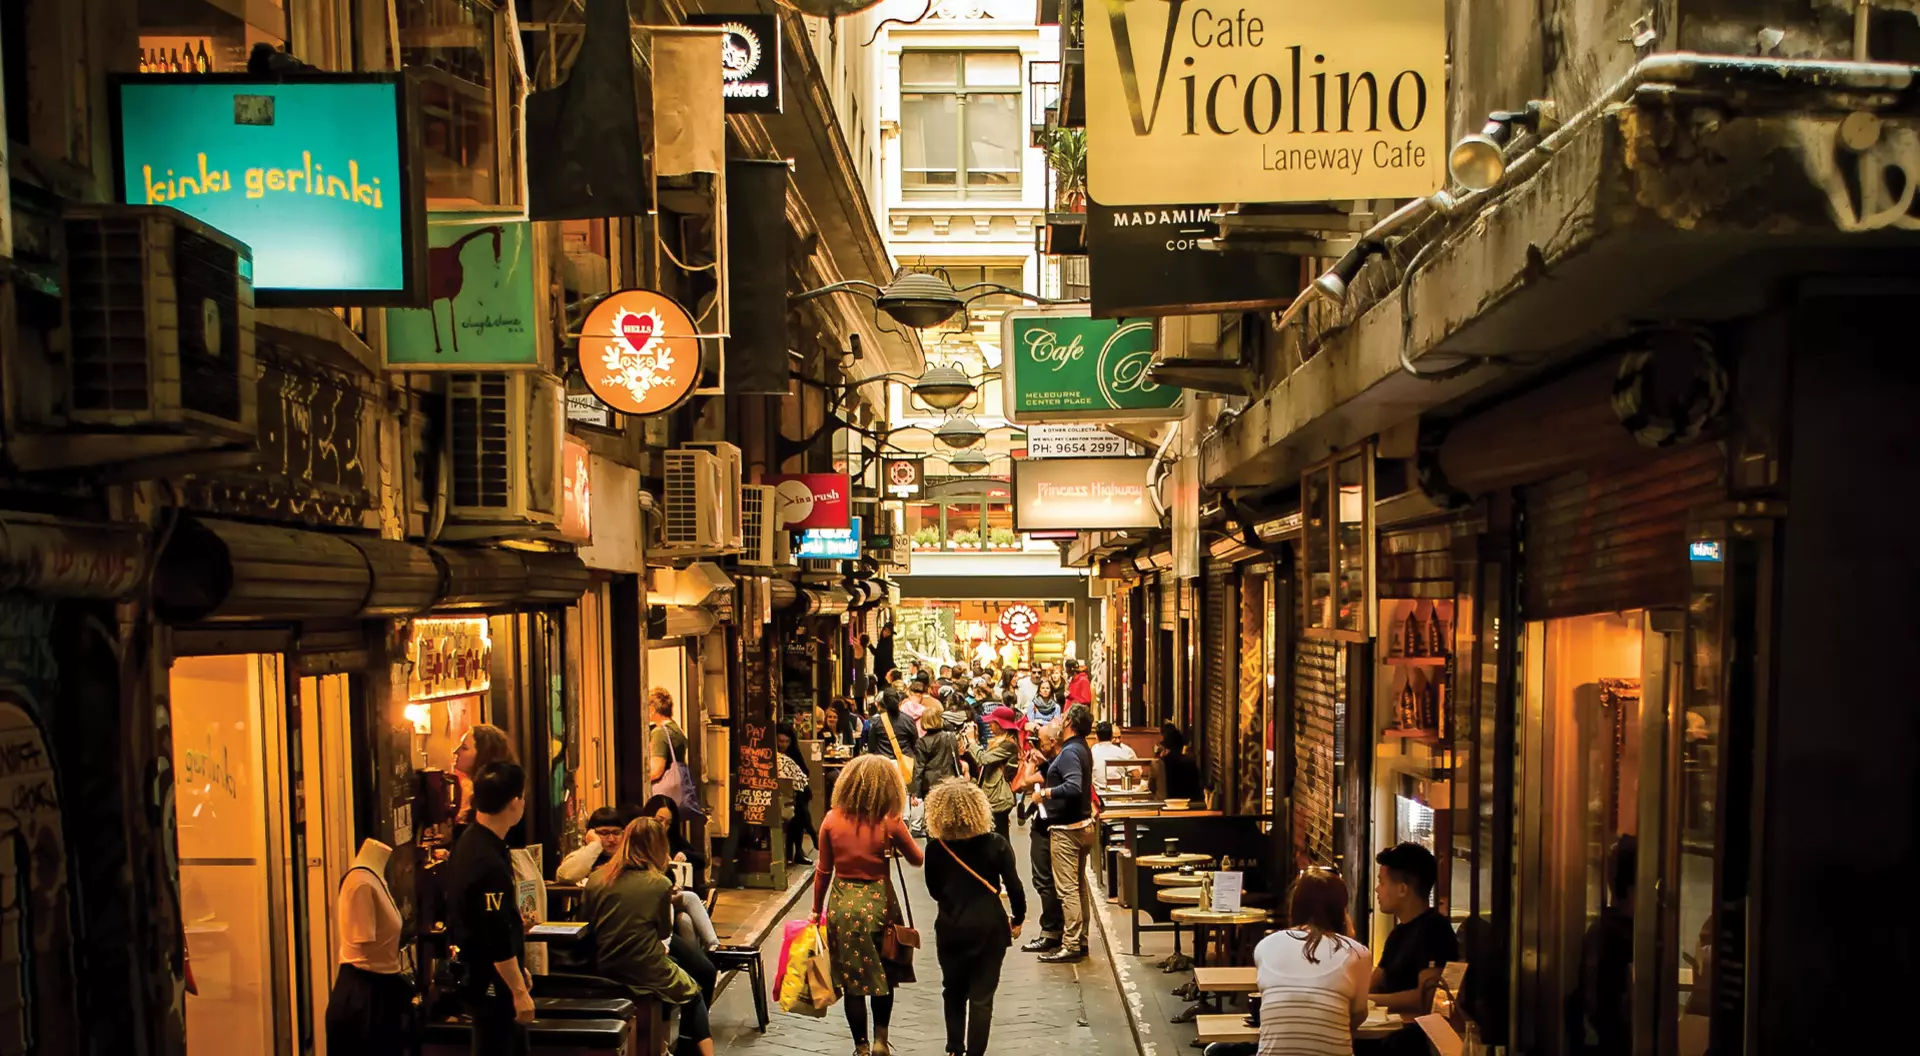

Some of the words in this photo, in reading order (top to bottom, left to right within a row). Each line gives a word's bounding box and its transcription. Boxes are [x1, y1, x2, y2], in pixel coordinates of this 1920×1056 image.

[1191, 8, 1265, 48] Cafe
[1107, 0, 1428, 137] Vicolino
[1262, 143, 1363, 175] Laneway
[1373, 140, 1426, 168] Cafe
[142, 152, 232, 205] kinki
[245, 150, 383, 209] gerlinki
[1113, 209, 1212, 227] MADAMIM
[1165, 238, 1198, 251] COF
[623, 325, 652, 333] HELLS
[1024, 328, 1085, 371] Cafe
[1026, 398, 1061, 406] CENTER
[1064, 397, 1092, 405] PLACE
[1032, 443, 1052, 453] PH:
[1056, 443, 1086, 453] 9654
[1090, 442, 1120, 452] 2997
[813, 489, 840, 502] rush
[1033, 482, 1088, 506] Princess
[1091, 480, 1143, 504] Highway
[745, 724, 766, 739] PAY
[750, 738, 761, 747] IT
[485, 892, 504, 911] IV
